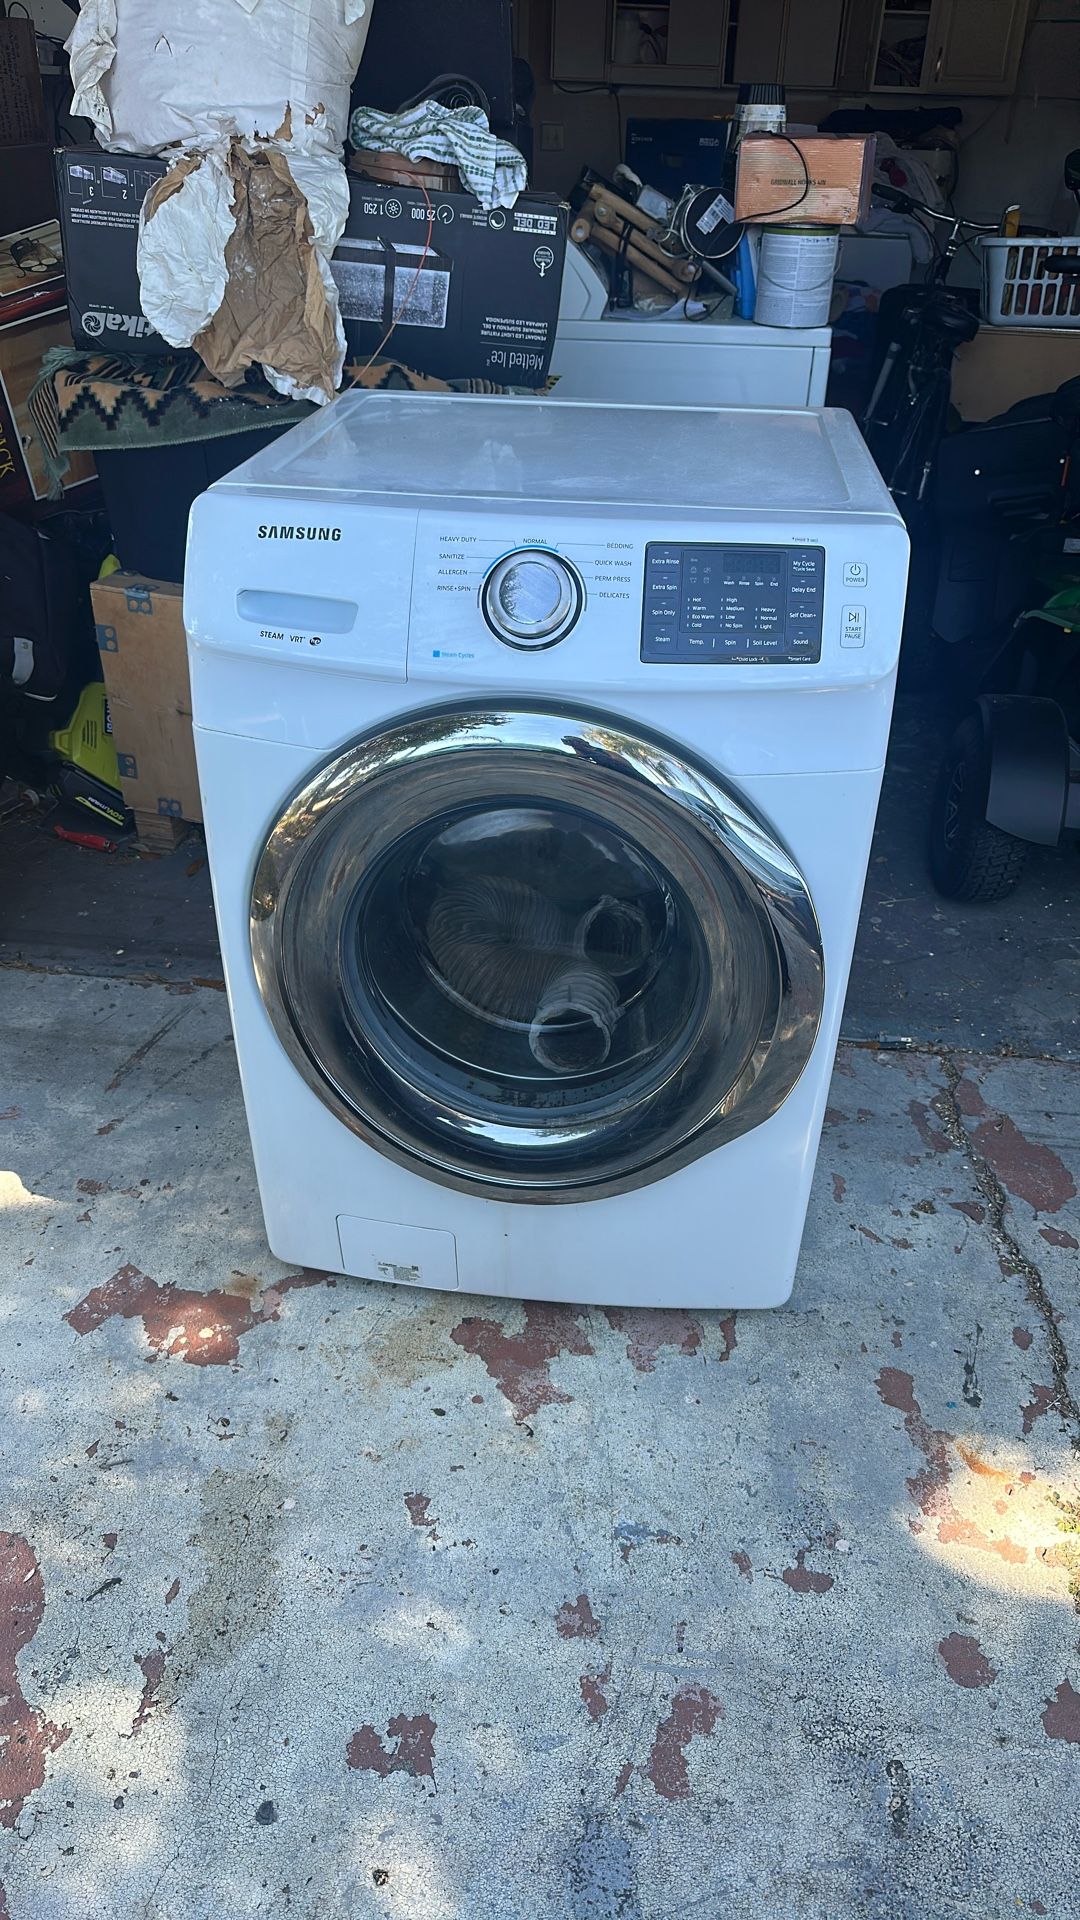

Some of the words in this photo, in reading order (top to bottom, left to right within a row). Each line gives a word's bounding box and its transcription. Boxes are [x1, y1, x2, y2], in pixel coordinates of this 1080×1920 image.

[89, 186, 94, 196] 3
[122, 190, 128, 199] 2
[363, 202, 377, 214] 250
[411, 208, 425, 220] 000
[514, 217, 533, 228] DEL
[537, 220, 556, 230] LED
[106, 313, 159, 338] tika
[509, 352, 544, 370] Melted
[258, 526, 342, 541] SAMSUNG
[260, 630, 284, 640] STEAM
